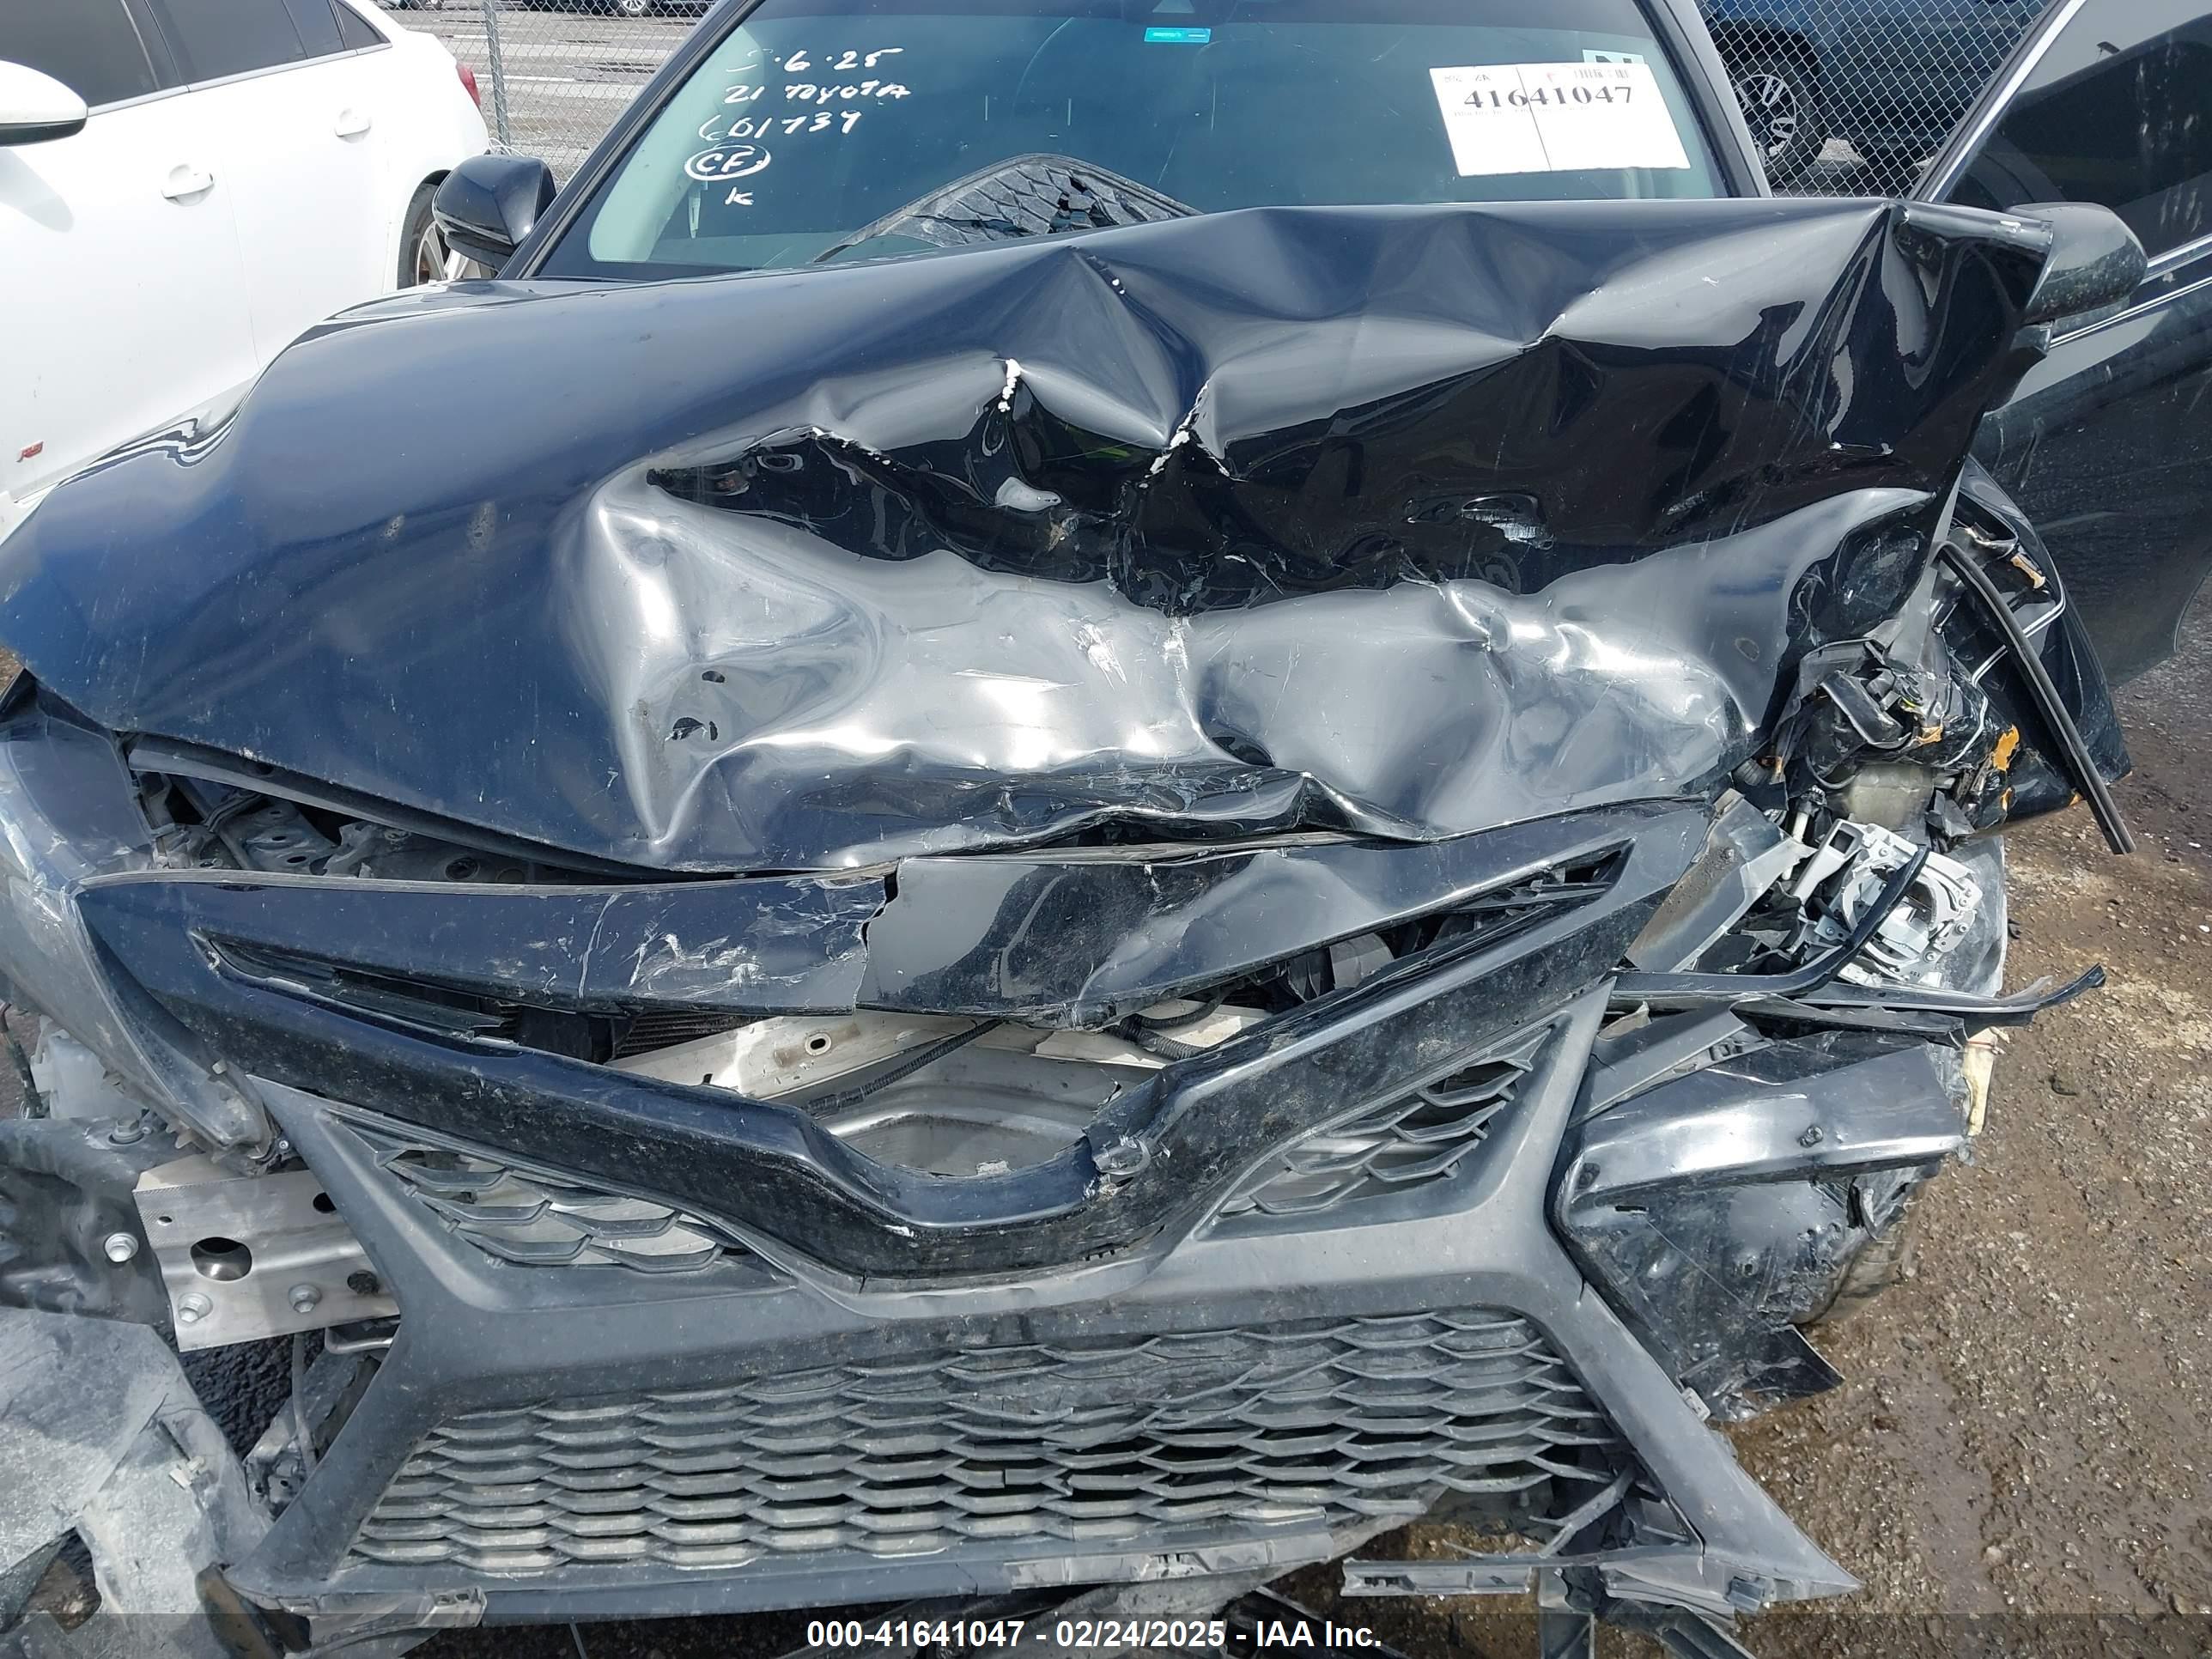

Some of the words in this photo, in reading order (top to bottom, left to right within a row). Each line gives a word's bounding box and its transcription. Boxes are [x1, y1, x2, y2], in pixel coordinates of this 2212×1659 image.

[723, 85, 765, 104] 21
[1464, 86, 1632, 108] 41641047
[696, 150, 755, 173] CF
